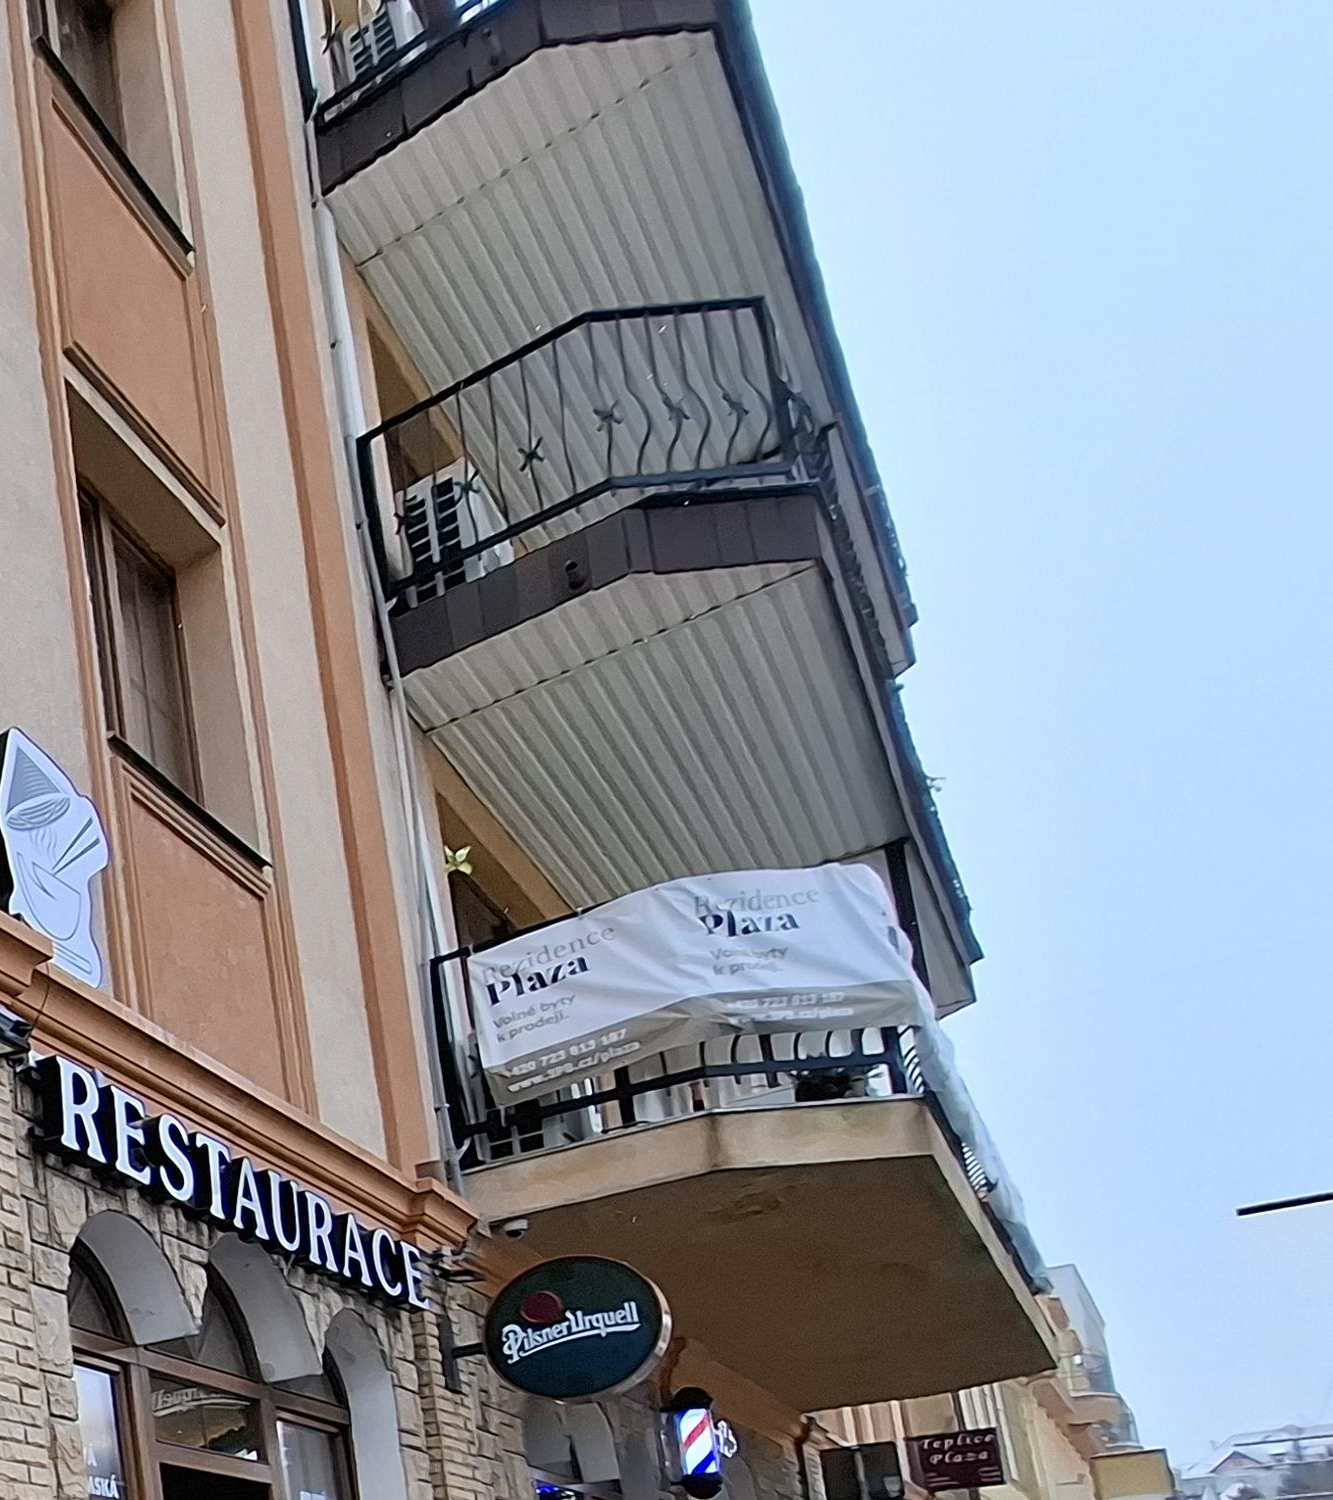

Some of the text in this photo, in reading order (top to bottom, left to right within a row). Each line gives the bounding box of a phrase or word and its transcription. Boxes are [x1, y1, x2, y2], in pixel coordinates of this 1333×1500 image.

[484, 927, 617, 981] Rezidence
[486, 956, 589, 1008] Plaza
[493, 994, 577, 1030] Volné byty
[497, 1031, 508, 1044] k
[55, 1055, 431, 1309] RESTAURACE
[501, 1300, 641, 1364] Pilsner Urquell
[929, 1451, 989, 1465] Plaza
